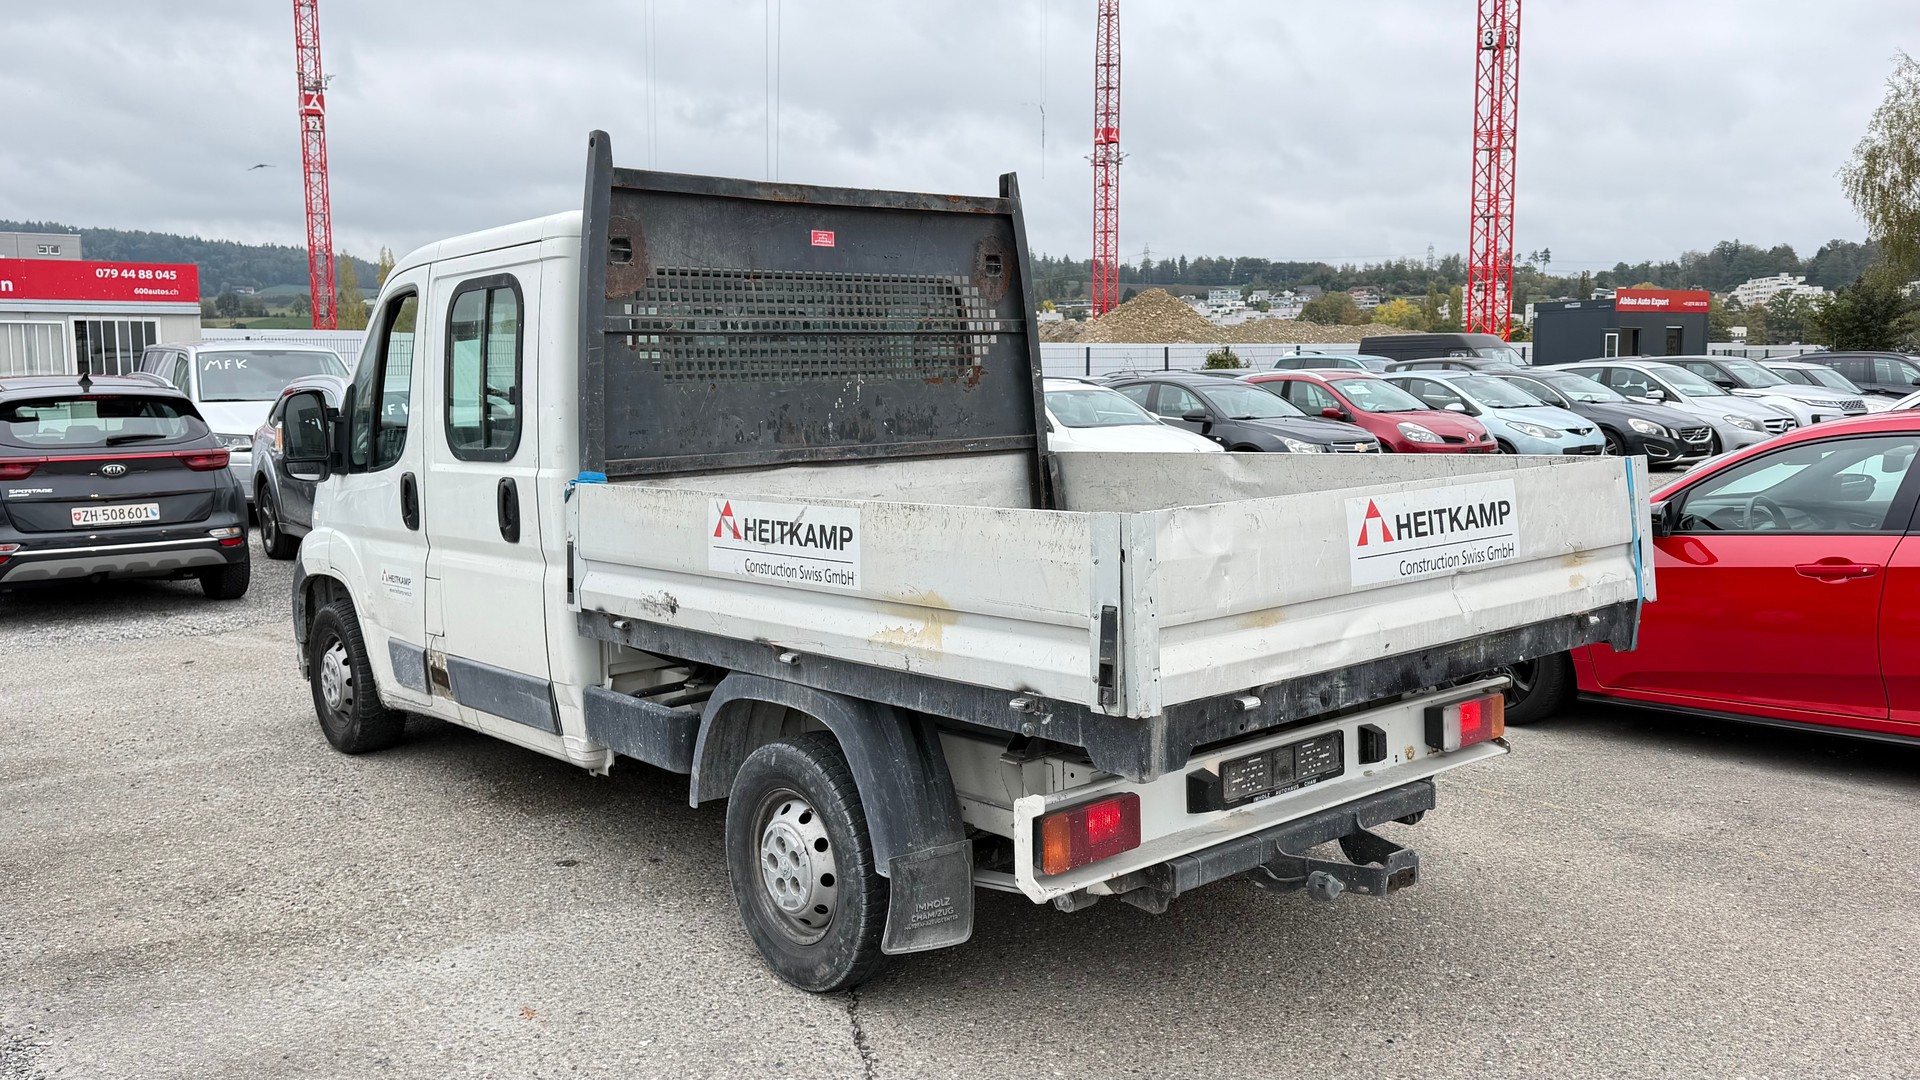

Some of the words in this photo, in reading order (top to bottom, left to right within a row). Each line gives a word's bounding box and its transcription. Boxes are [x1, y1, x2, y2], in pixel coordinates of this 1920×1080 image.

[1484, 30, 1494, 46] 3
[1508, 30, 1515, 46] 3
[311, 120, 318, 129] 2
[95, 268, 119, 279] 079
[120, 269, 136, 279] 44
[138, 269, 153, 280] 88
[155, 270, 177, 280] 045
[134, 287, 179, 296] 600autos.ch
[1637, 297, 1651, 306] Auto
[1651, 297, 1670, 307] Export
[204, 359, 248, 371] MFK
[105, 466, 123, 474] KIA
[1395, 499, 1511, 541] HEITKAMP
[744, 517, 854, 551] HEITKAMP
[1400, 552, 1460, 576] Construction
[1461, 549, 1485, 566] Swiss
[1487, 542, 1515, 561] GmbH
[744, 558, 797, 579] Construction
[799, 564, 823, 583] Swiss
[824, 568, 855, 586] GmbH
[915, 897, 951, 913] IMHOLZ
